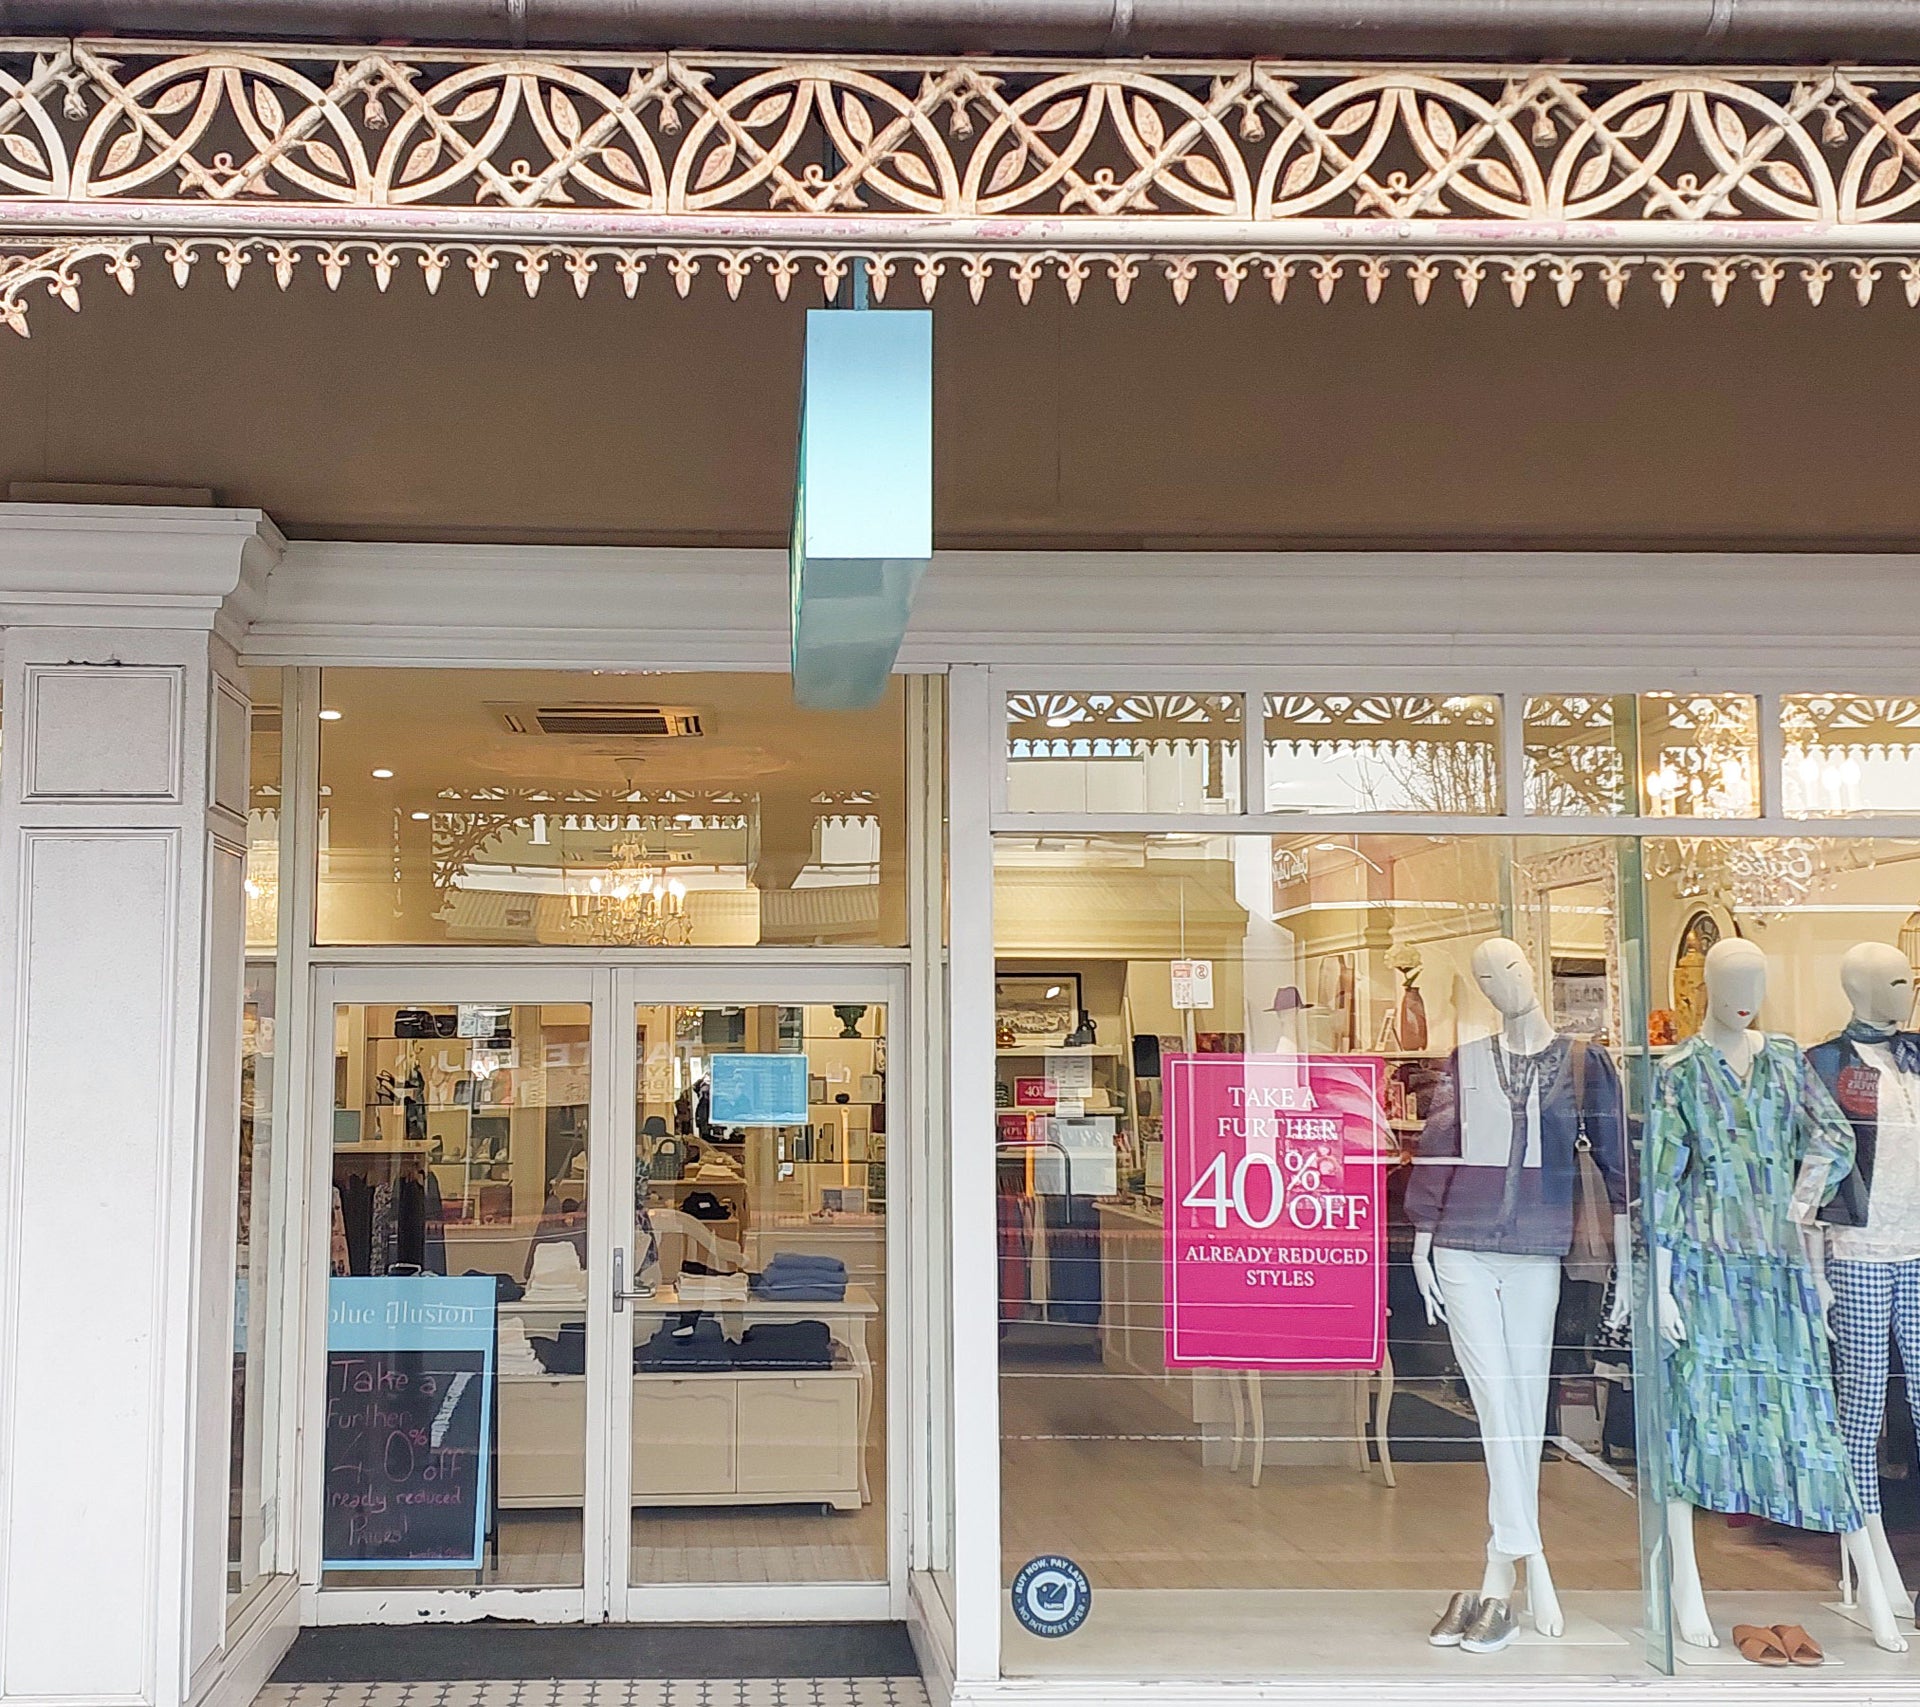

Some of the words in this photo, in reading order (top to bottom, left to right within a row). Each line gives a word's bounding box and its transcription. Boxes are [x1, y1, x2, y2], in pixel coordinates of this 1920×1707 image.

[1227, 1086, 1296, 1108] TAKE
[1302, 1086, 1319, 1108] A
[1217, 1117, 1339, 1140] FURTHER
[1288, 1193, 1370, 1230] OFF
[1184, 1245, 1275, 1263] ALREADY
[1277, 1247, 1369, 1265] REDUCED
[1245, 1269, 1316, 1287] STYLES
[385, 1299, 475, 1325] illusion
[330, 1359, 410, 1393] Take
[420, 1374, 438, 1395] a
[423, 1446, 462, 1481] off
[395, 1484, 462, 1505] reduced
[1015, 1572, 1028, 1594] BUY
[1050, 1558, 1068, 1570] PAY
[1067, 1565, 1087, 1593] LATER
[1018, 1605, 1031, 1621] NO
[1028, 1618, 1069, 1634] INTEREST
[1067, 1604, 1086, 1626] EVER
